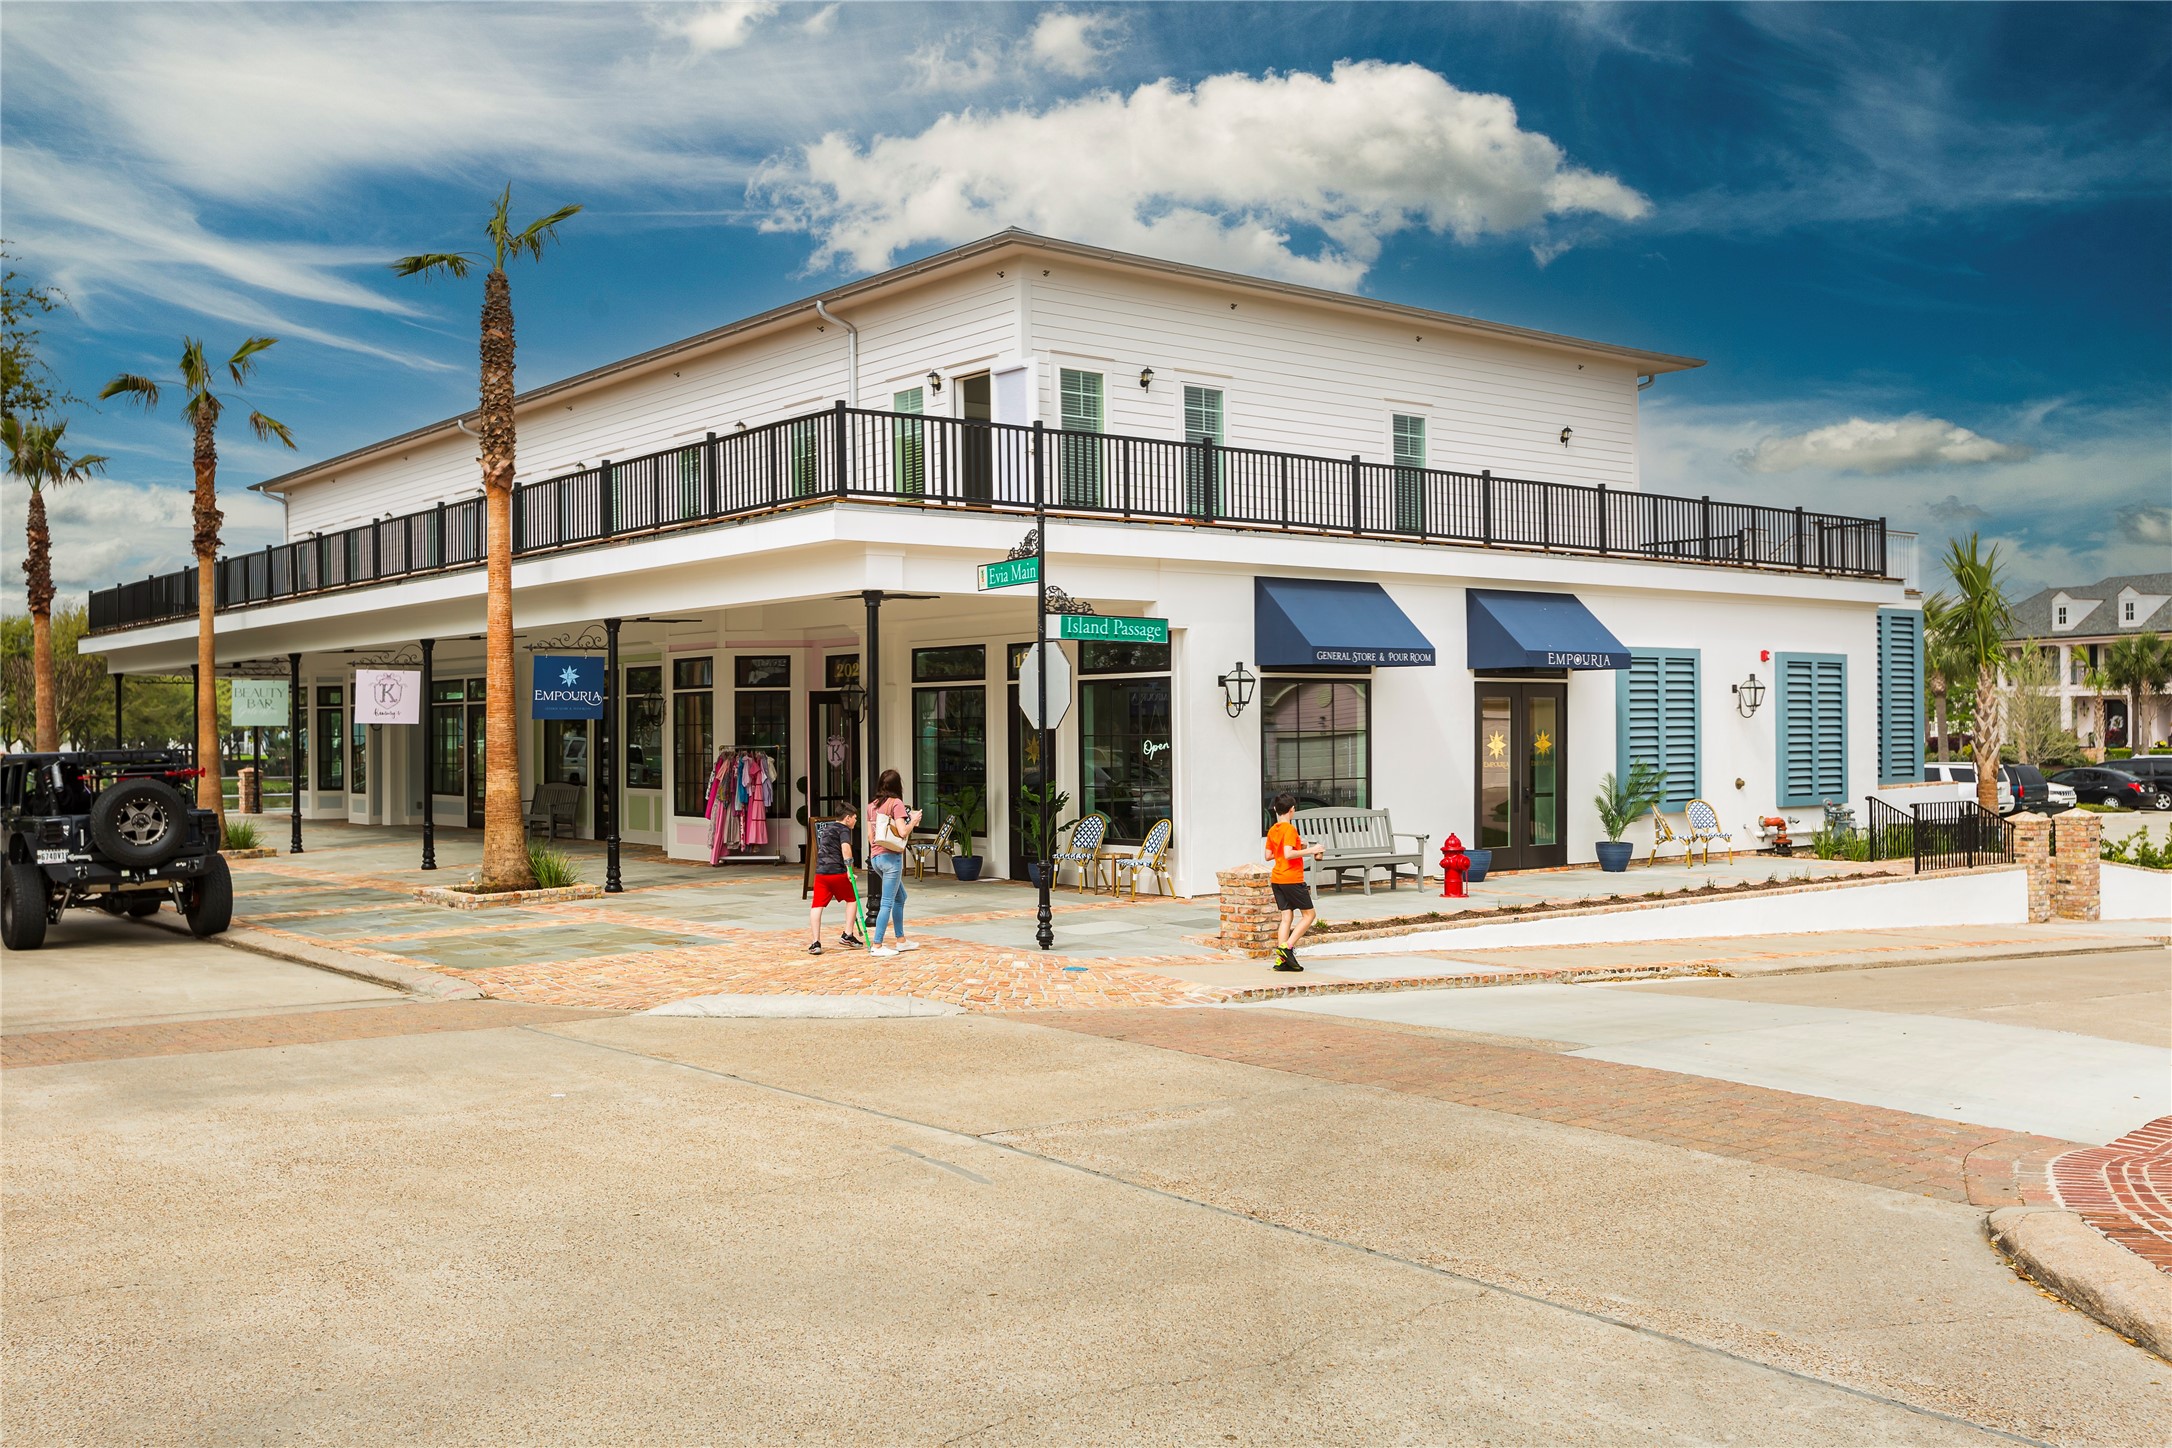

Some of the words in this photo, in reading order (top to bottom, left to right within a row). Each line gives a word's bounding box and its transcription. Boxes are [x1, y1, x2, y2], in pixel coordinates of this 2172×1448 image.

[989, 566, 1009, 585] Evia
[1011, 562, 1037, 581] Main
[1066, 617, 1109, 635] Island
[1113, 619, 1161, 642] Passage
[1316, 650, 1351, 661] GENERAL
[1352, 651, 1377, 663] STORE
[1379, 652, 1385, 662] &
[1388, 652, 1409, 662] POUR
[1410, 652, 1432, 663] ROOM
[1548, 652, 1611, 668] EMPOURIA
[234, 687, 286, 698] BEAUTY
[379, 683, 398, 703] K
[534, 689, 603, 707] EMPOURIA
[247, 698, 276, 710] BAR
[830, 744, 842, 761] K
[1143, 739, 1170, 761] Open
